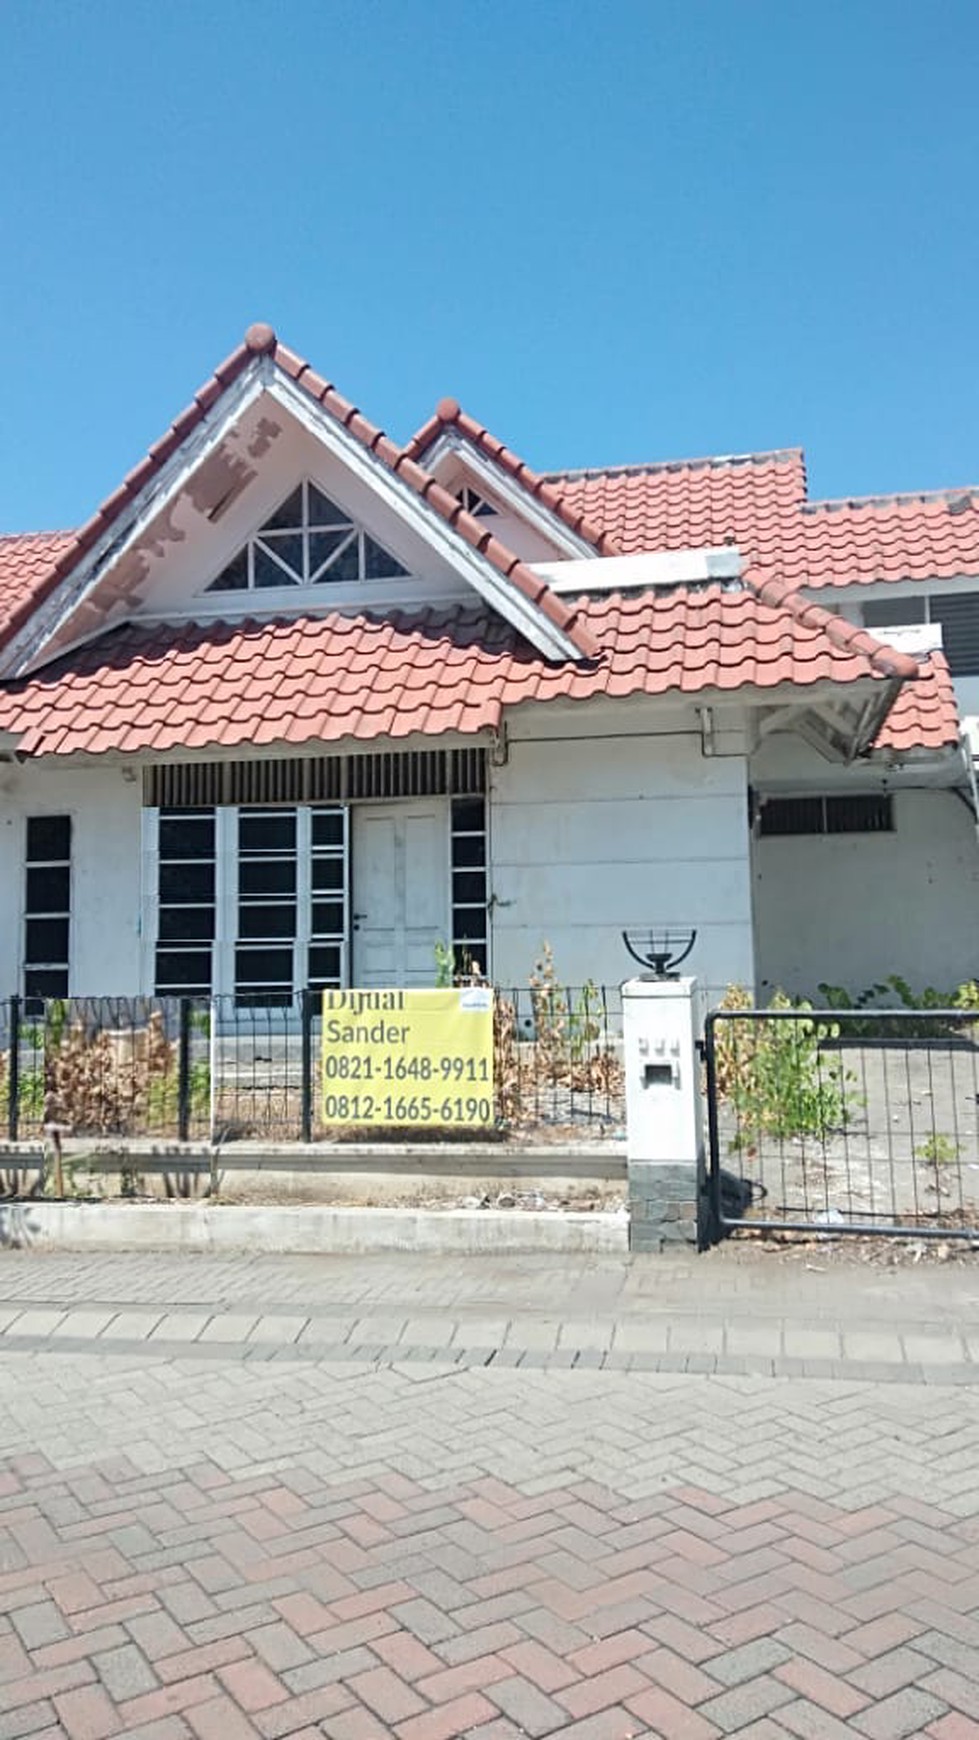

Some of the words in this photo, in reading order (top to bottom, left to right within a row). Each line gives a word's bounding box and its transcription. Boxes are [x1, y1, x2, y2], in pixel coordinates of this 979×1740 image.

[327, 1019, 410, 1044] Sander
[325, 1056, 489, 1082] 0821-1648-9911
[325, 1095, 491, 1123] 0812-1665-6190
